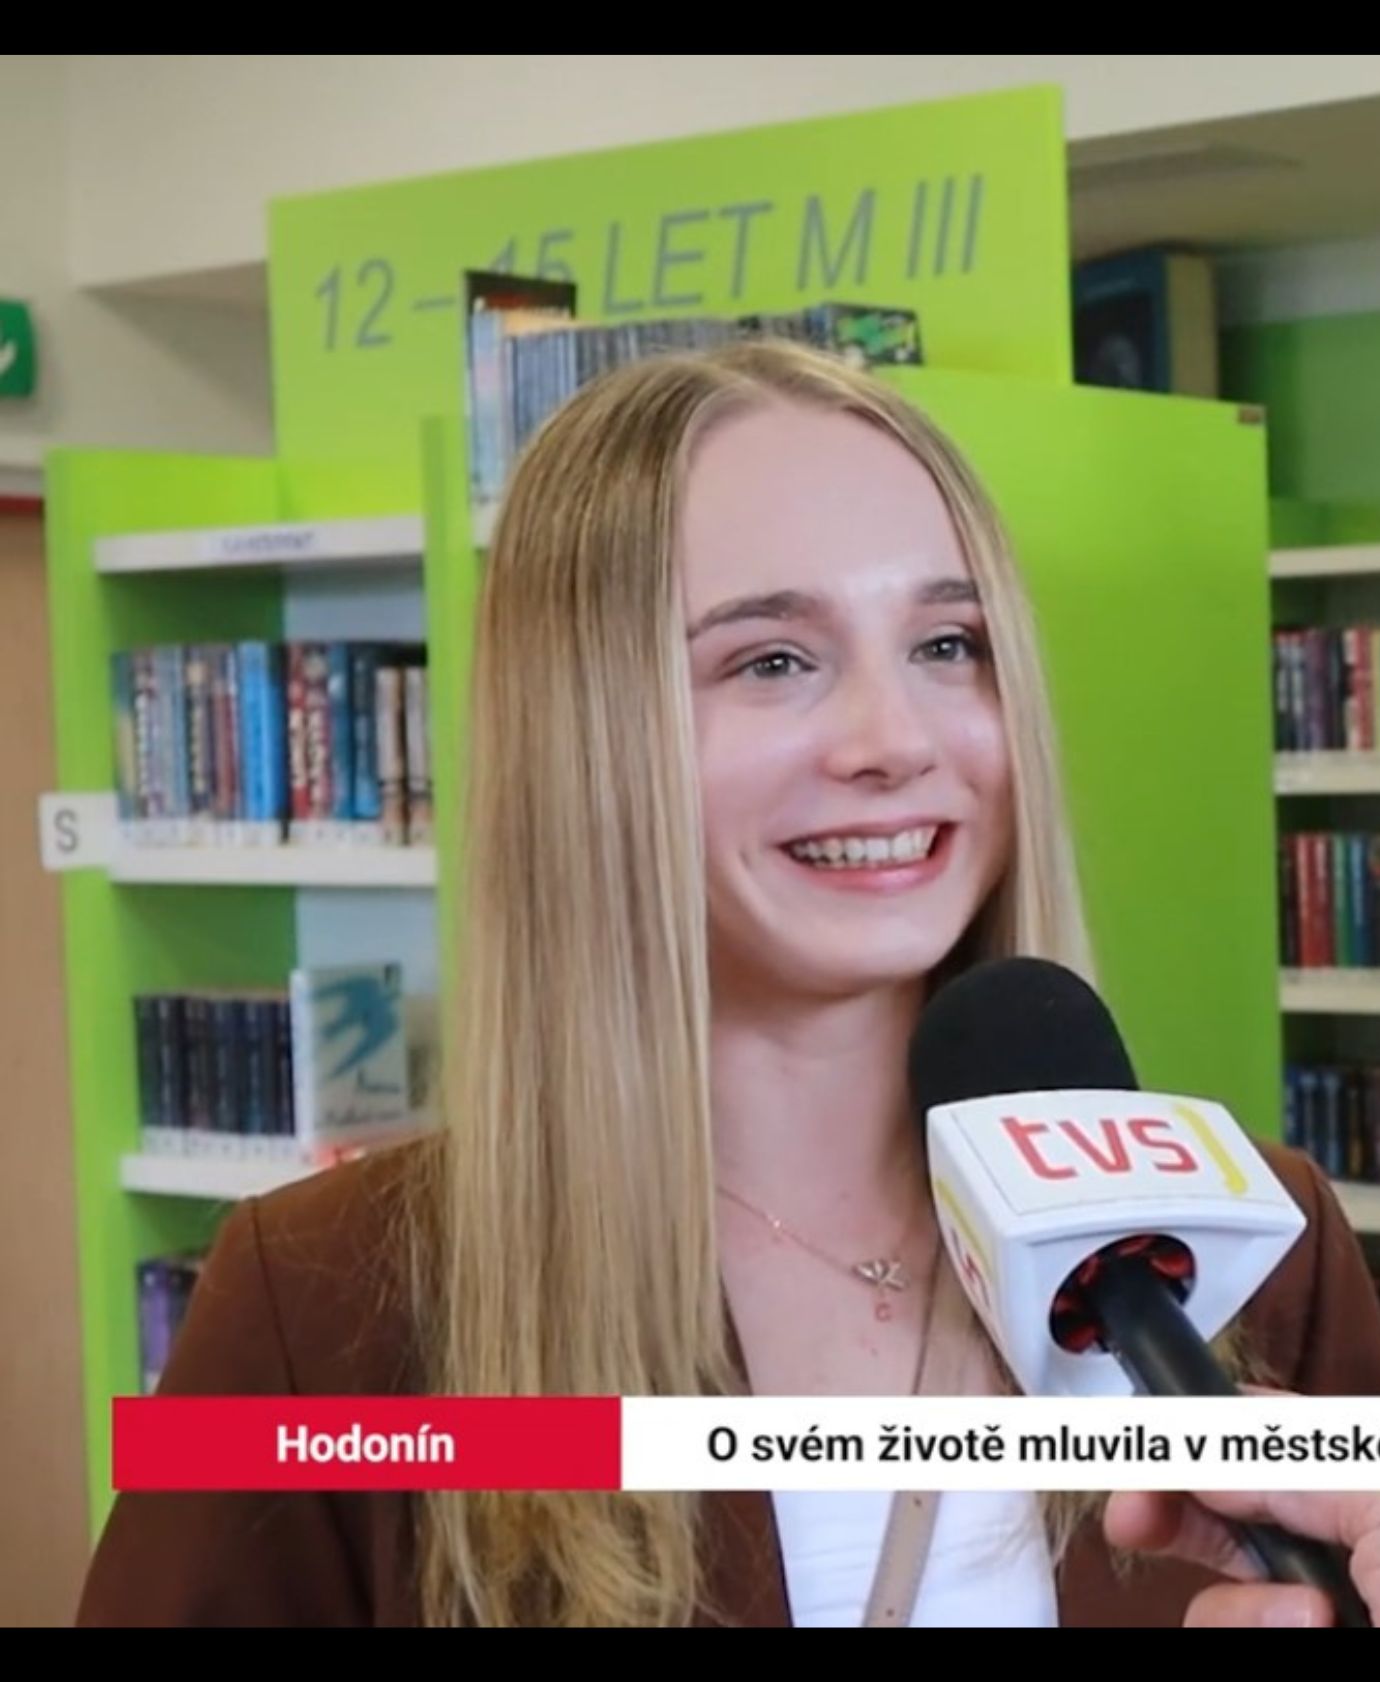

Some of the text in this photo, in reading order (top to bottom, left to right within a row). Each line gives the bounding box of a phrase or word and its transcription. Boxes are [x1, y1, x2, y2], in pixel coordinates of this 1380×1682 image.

[316, 258, 398, 350] 12
[605, 201, 774, 315] LET
[796, 186, 876, 292] M
[904, 172, 984, 280] III
[53, 809, 80, 853] S
[1001, 1117, 1198, 1181] tvs
